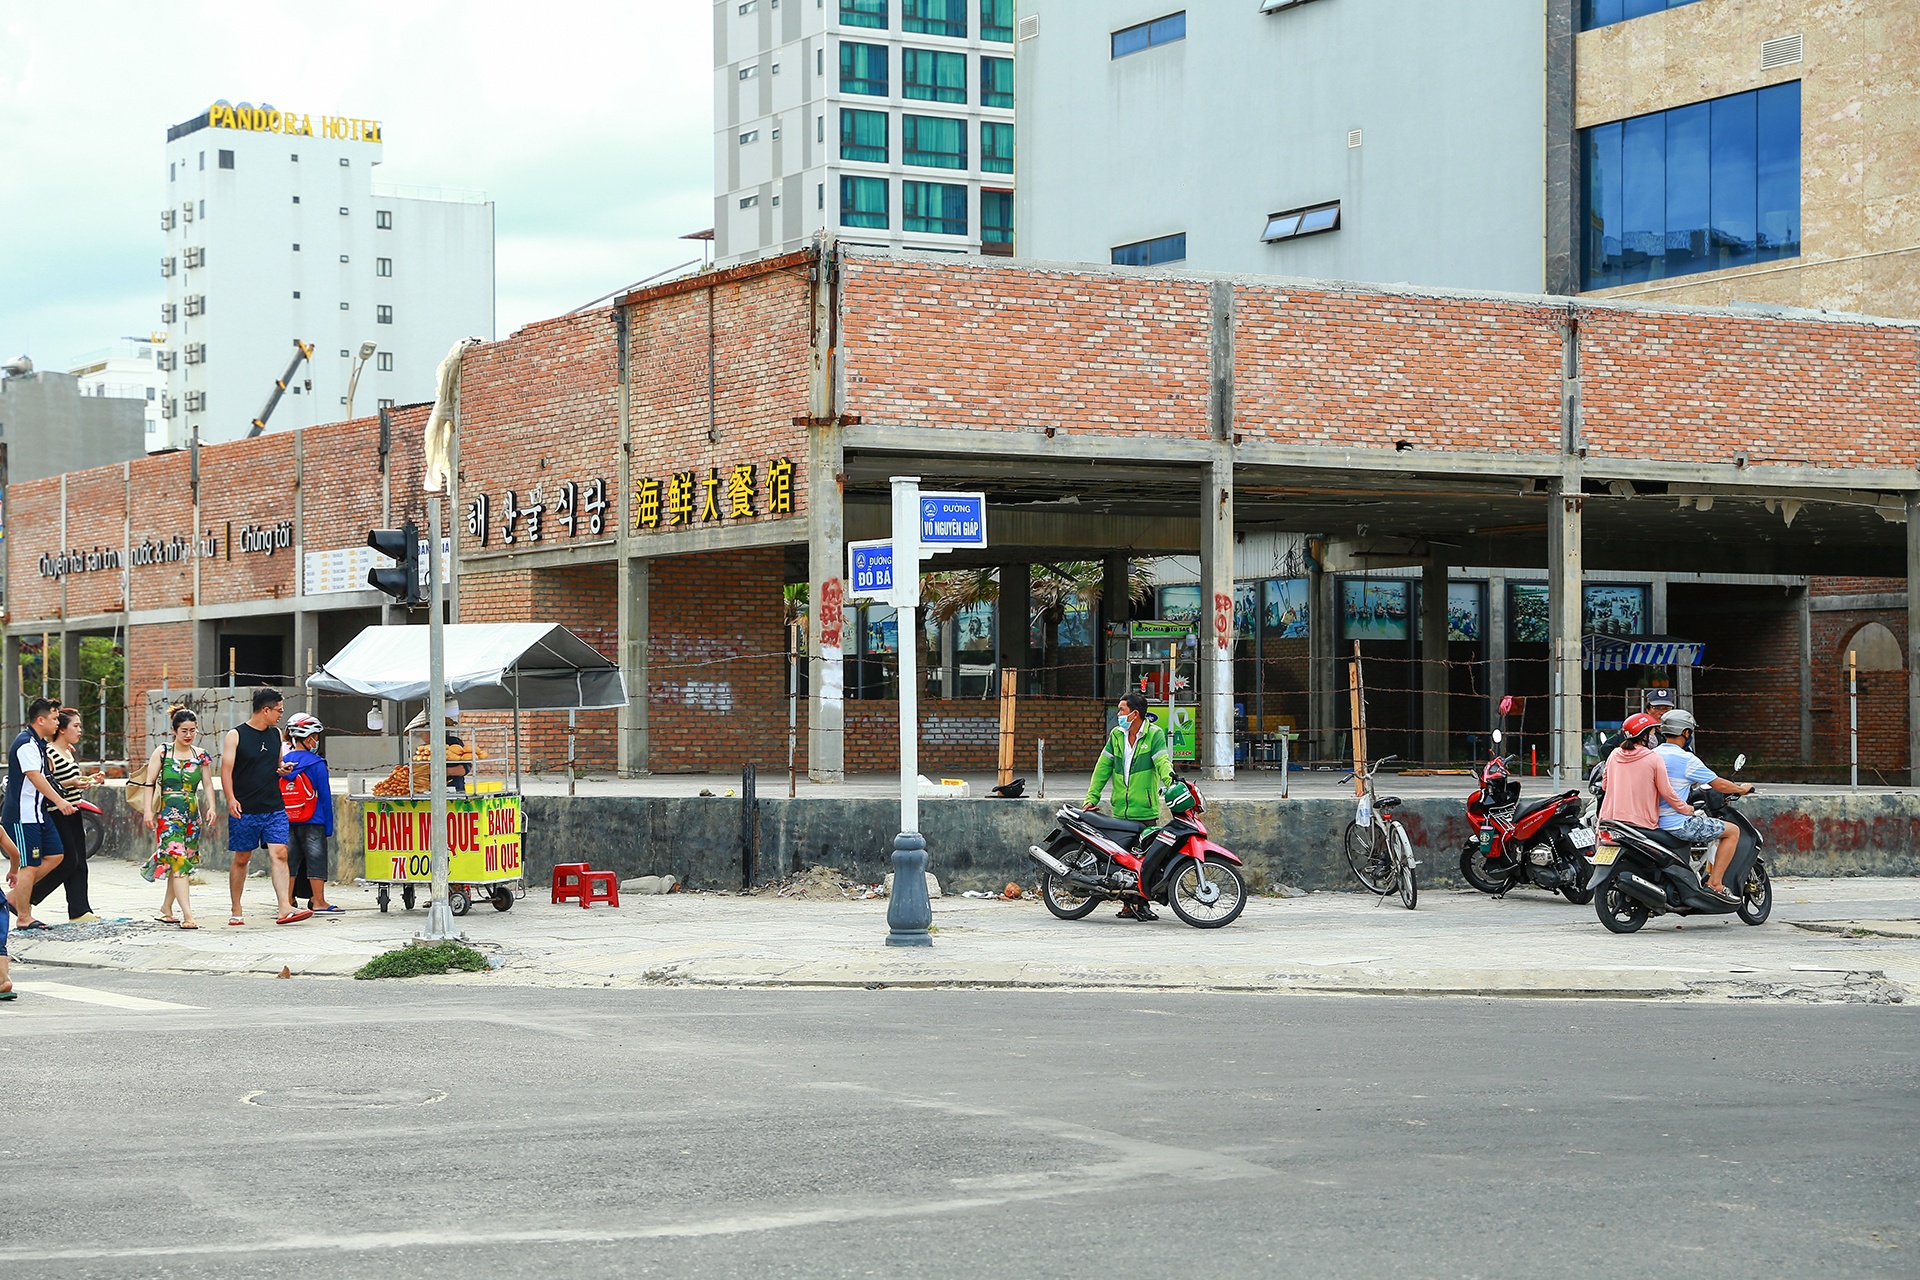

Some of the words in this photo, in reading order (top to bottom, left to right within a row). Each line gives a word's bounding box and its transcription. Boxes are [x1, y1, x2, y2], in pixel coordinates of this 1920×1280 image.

[209, 105, 313, 137] PANDORA
[322, 115, 382, 143] HOTEL
[635, 457, 796, 528] 海鲜大餐馆
[943, 503, 971, 513] ĐƯỜNG
[240, 525, 274, 556] Chúng
[275, 522, 293, 549] tôi
[923, 518, 934, 536] VÕ
[934, 518, 962, 536] NGUYÊN
[963, 518, 979, 536] GIÁP
[155, 539, 165, 563] &
[870, 554, 892, 565] ĐƯỜNG
[858, 565, 874, 586] ĐỖ
[876, 566, 892, 585] BÁ
[366, 803, 413, 851] BÁNH
[419, 812, 432, 851] M
[446, 812, 480, 856] QUE
[488, 804, 515, 836] BÁNH
[392, 857, 407, 879] 7K
[485, 839, 498, 872] MÌ
[501, 842, 519, 873] QUE
